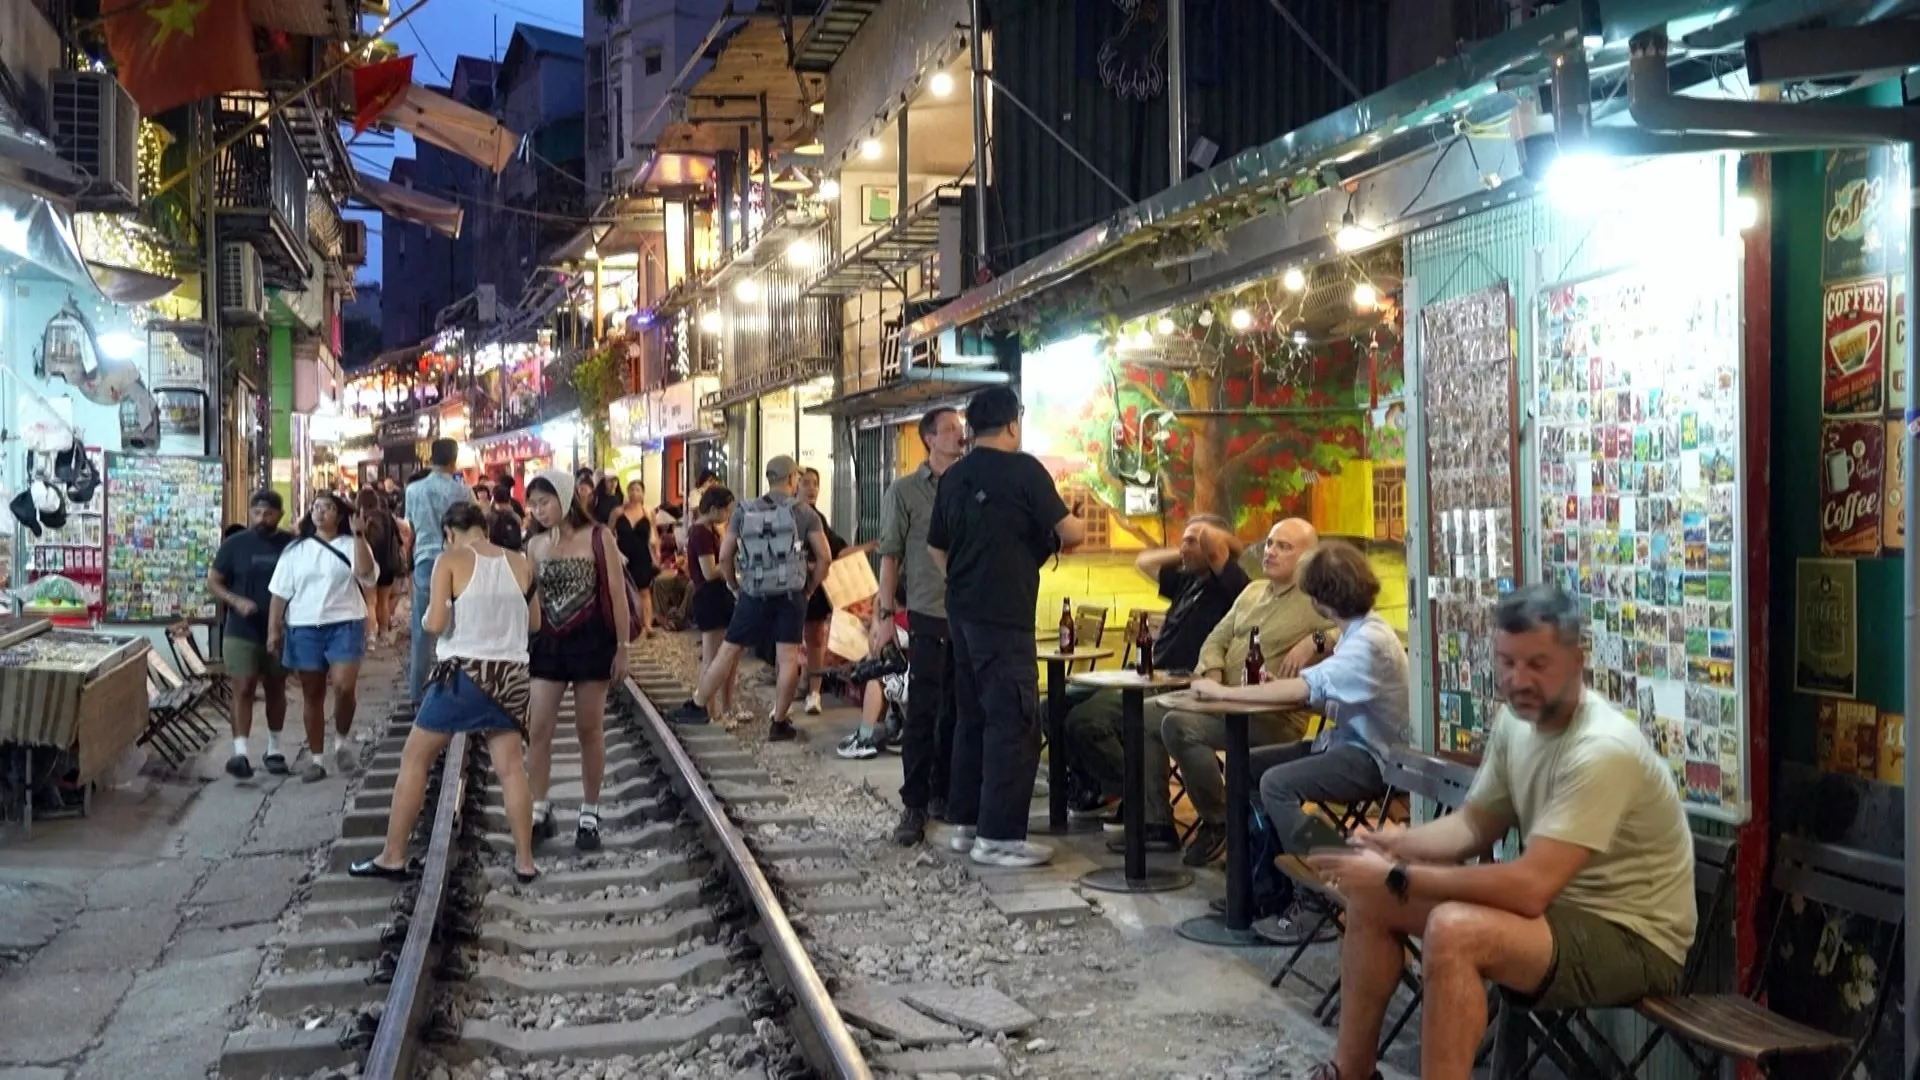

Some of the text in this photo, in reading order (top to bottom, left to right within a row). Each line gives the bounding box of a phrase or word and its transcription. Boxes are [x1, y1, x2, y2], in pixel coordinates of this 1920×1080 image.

[1827, 177, 1882, 242] Coffee
[1827, 286, 1883, 321] COFFEE
[1823, 490, 1877, 532] Coffee
